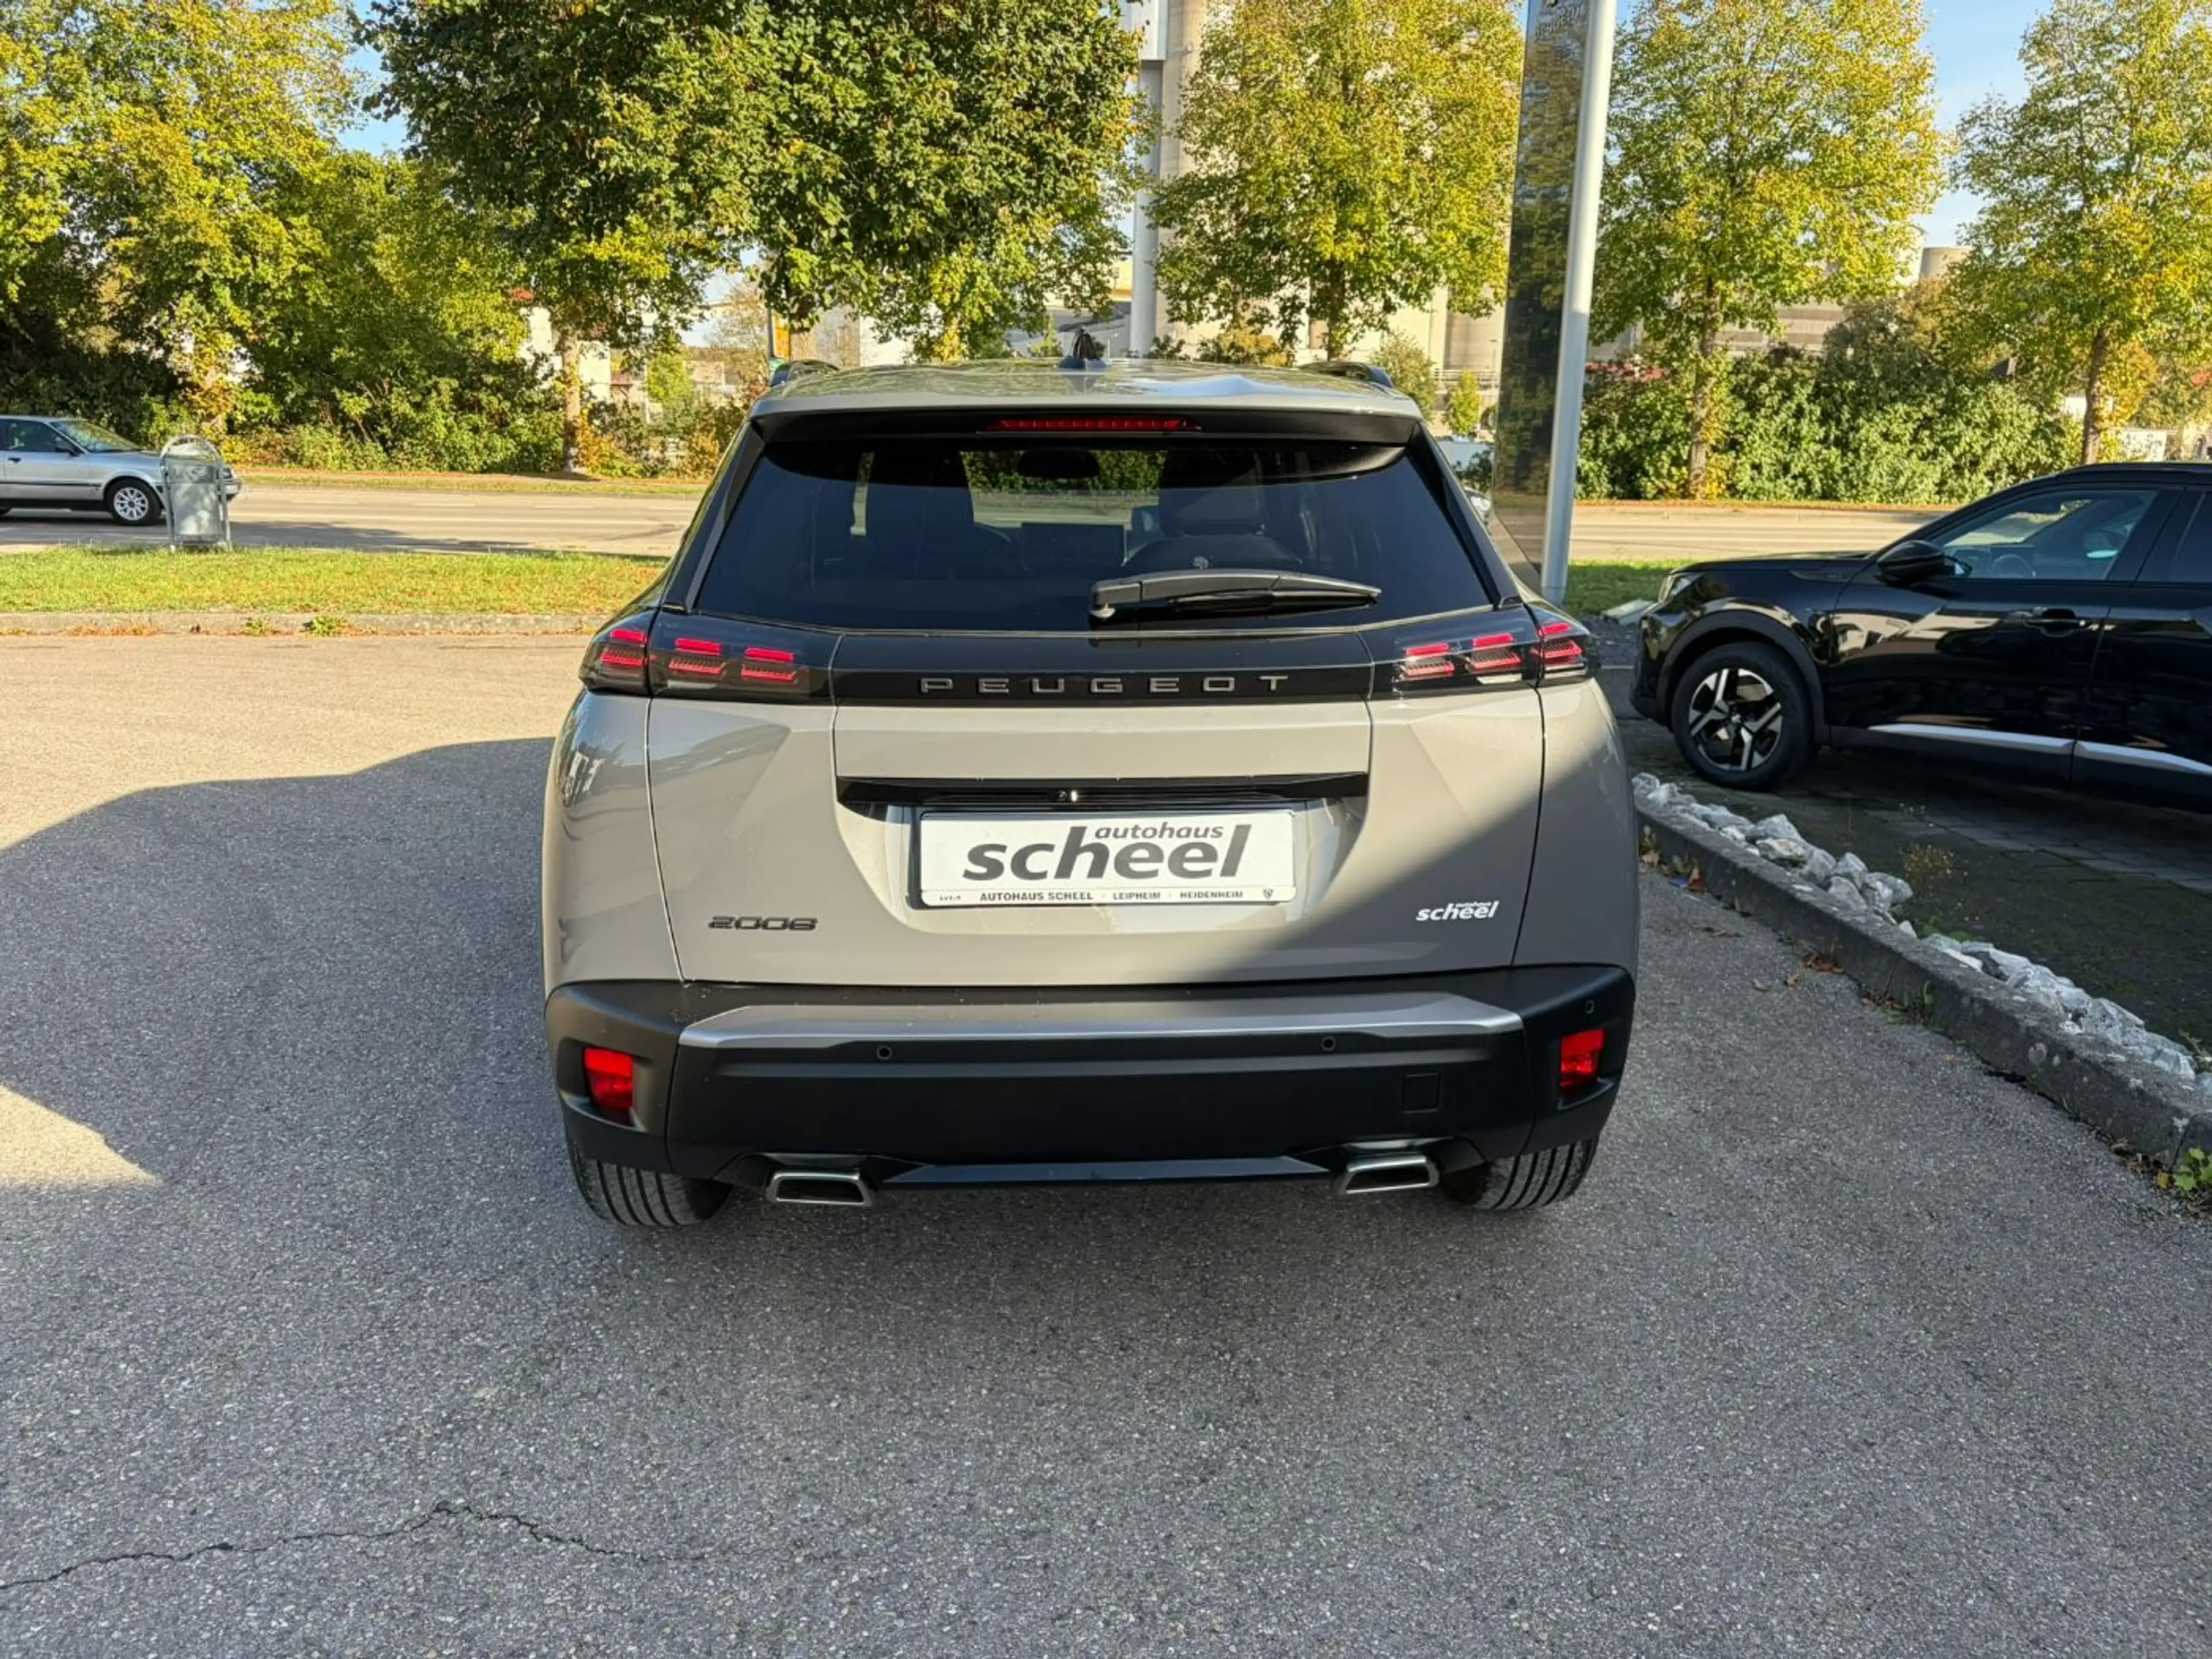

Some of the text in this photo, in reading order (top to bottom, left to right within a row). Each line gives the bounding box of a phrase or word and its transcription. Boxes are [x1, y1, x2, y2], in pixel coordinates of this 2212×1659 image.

[921, 676, 1288, 693] PEUGEOT
[1094, 821, 1224, 839] autohaus
[963, 824, 1252, 881] scheel
[980, 891, 1244, 902] AUTOHAUS SCHEEL LEIPHEIM HEIDENHEIM
[1415, 900, 1499, 921] scheel
[708, 916, 818, 931] 2008
